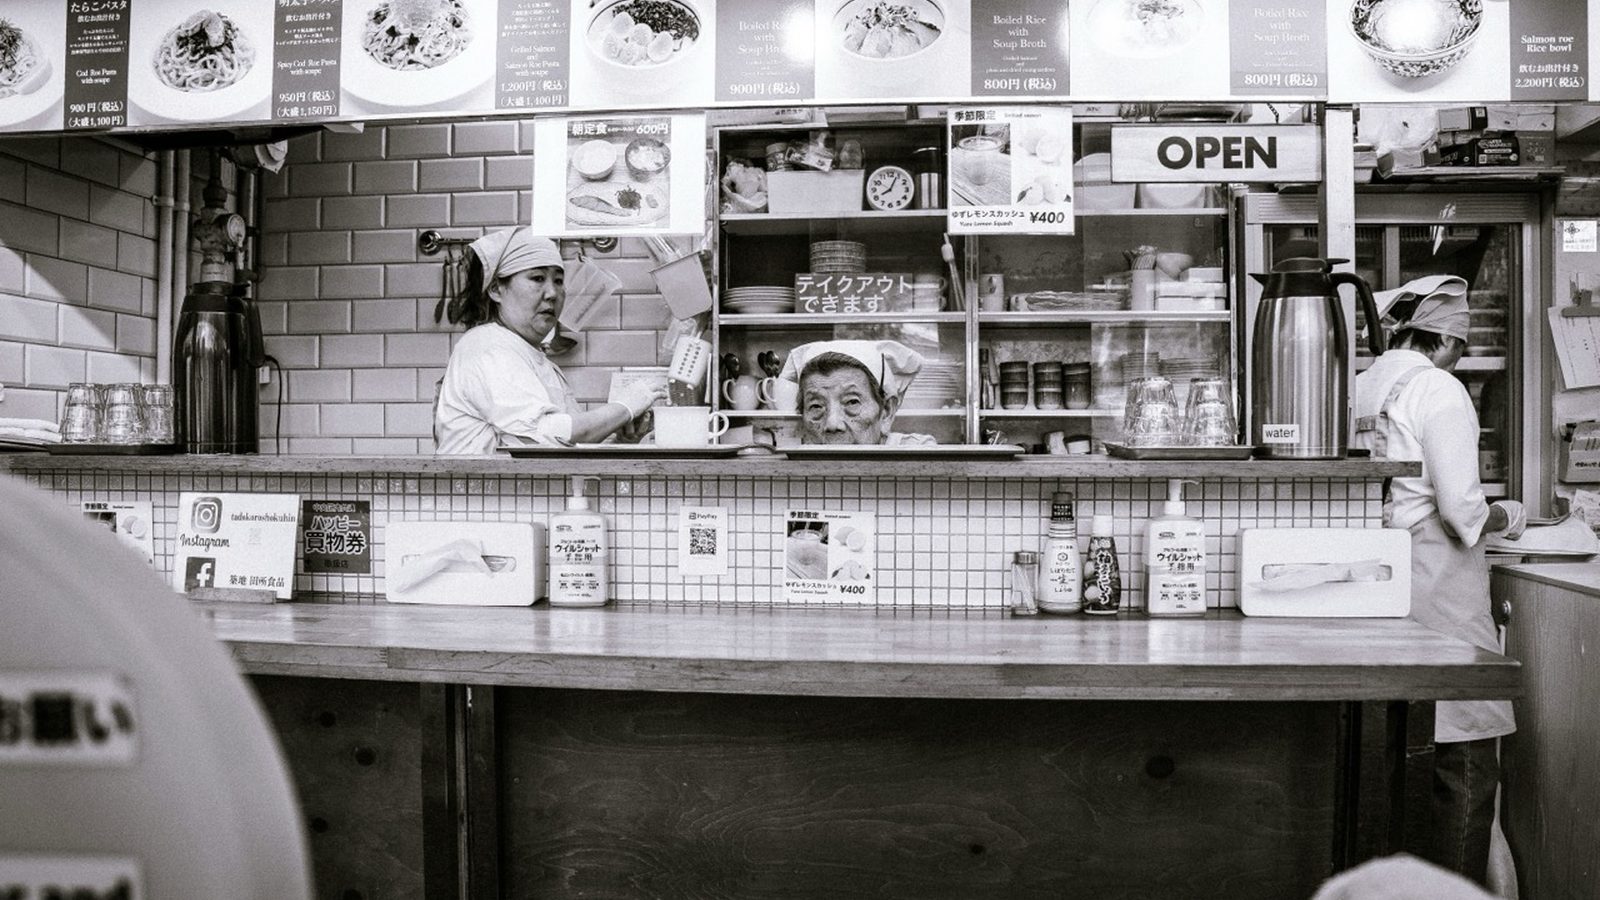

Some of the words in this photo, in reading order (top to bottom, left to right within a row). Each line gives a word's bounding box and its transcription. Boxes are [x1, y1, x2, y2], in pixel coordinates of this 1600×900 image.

[71, 0, 127, 12] たらこパスタ
[1254, 8, 1285, 18] Boiled
[993, 15, 1023, 25] Boiled
[1025, 14, 1047, 25] Rice
[1008, 27, 1029, 37] with
[1254, 32, 1279, 45] Soup
[1282, 32, 1311, 42] Broth
[1520, 35, 1556, 44] Salmon
[993, 39, 1018, 51] Soup
[1020, 39, 1047, 48] Broth
[1527, 44, 1547, 52] Rice
[1549, 43, 1572, 52] bowl
[955, 110, 996, 121] 季節限定
[572, 122, 607, 136] 朝定食
[636, 123, 668, 135] 600円
[1157, 136, 1277, 170] OPEN
[951, 210, 1025, 219] ゆずレモンスカッシュ
[1030, 211, 1065, 224] ¥400
[797, 275, 914, 294] テイクアウト
[799, 294, 884, 313] できます
[1265, 428, 1295, 438] water
[311, 515, 361, 531] ハッピー
[180, 534, 230, 552] Instagram
[305, 530, 367, 555] 買物券
[1157, 552, 1202, 562] ウイルシャット
[840, 585, 865, 595] ¥400
